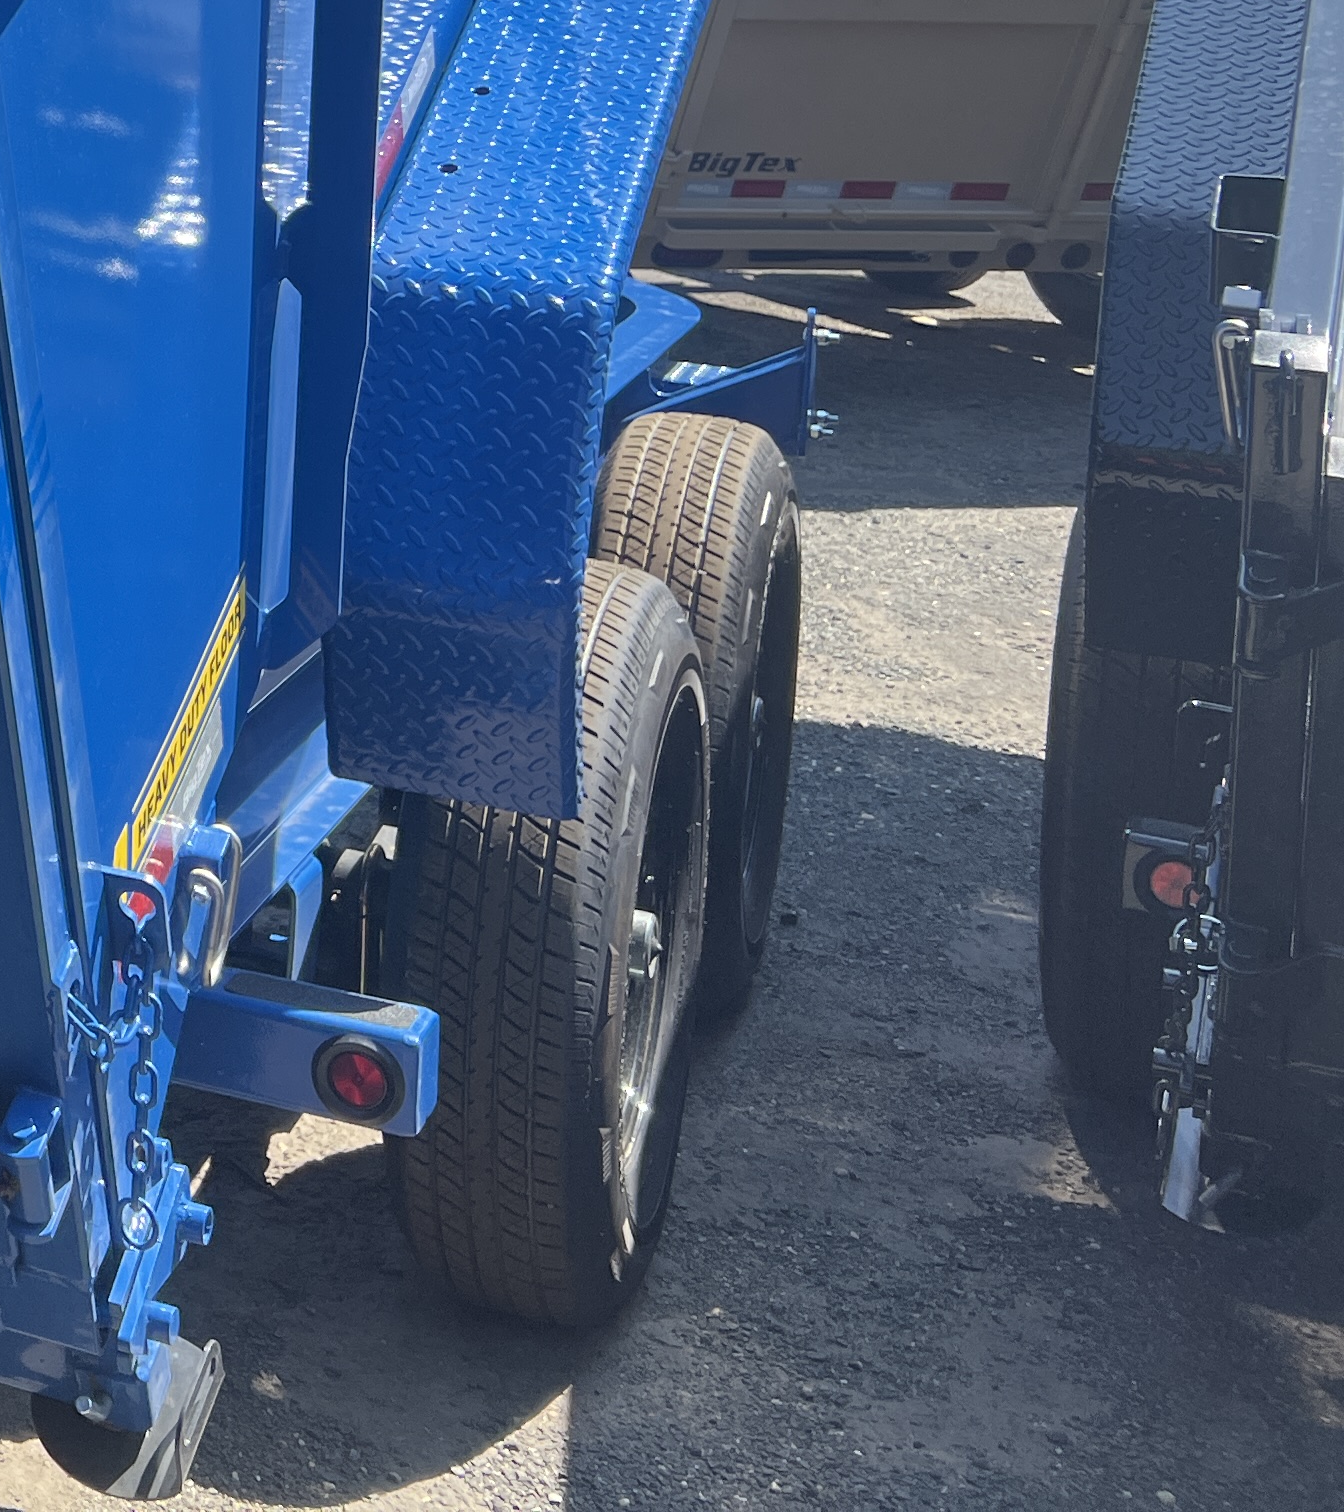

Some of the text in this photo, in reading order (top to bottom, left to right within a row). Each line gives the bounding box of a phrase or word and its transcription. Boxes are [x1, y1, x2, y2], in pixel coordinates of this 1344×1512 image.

[687, 151, 803, 178] BigTex
[137, 740, 178, 848] HEAVY
[179, 682, 207, 757] DUTY
[209, 597, 241, 686] FLOOR
